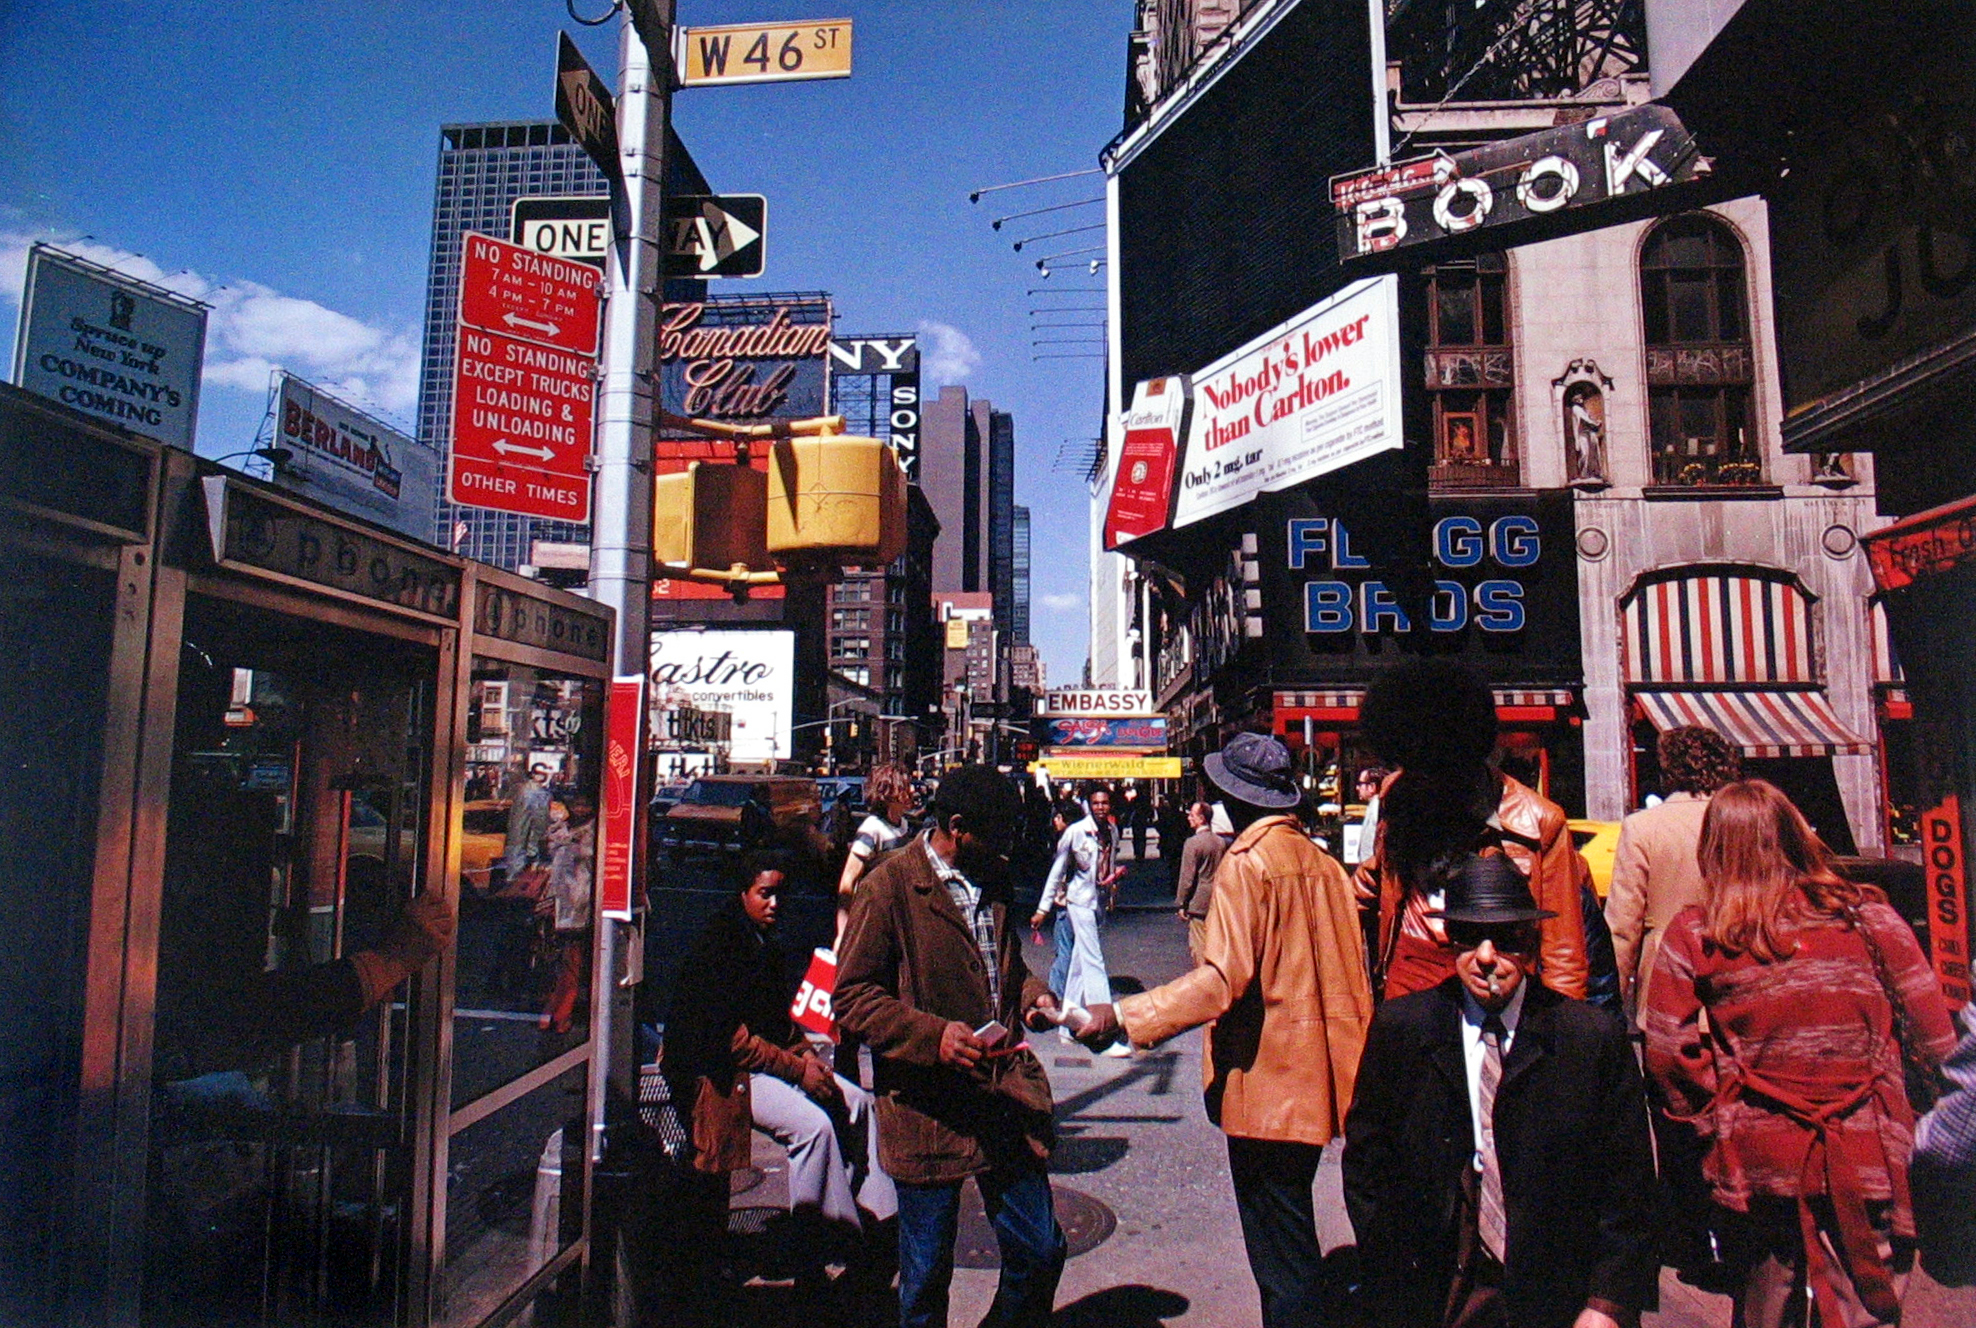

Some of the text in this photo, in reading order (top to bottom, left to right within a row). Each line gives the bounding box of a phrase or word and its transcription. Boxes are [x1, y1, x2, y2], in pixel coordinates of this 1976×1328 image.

[699, 28, 840, 77] W 46 ST
[1355, 128, 1673, 255] BOOK
[535, 223, 606, 252] ONE
[475, 242, 594, 290] NO STANDING
[492, 268, 501, 282] 7
[502, 272, 523, 287] AM
[540, 280, 554, 296] 10
[557, 286, 578, 302] AM
[488, 285, 498, 299] 4
[502, 290, 523, 305] PM
[542, 298, 550, 312] 7
[555, 302, 575, 318] PM
[71, 316, 138, 350] Spruce
[661, 302, 829, 360] Canadian
[74, 335, 160, 376] New York
[467, 334, 491, 356] NO
[505, 344, 588, 379] STANDING
[1203, 341, 1299, 420] Nobody's
[1302, 313, 1370, 370] lower
[40, 354, 181, 408] COMPANY'S
[462, 358, 590, 402] EXCEPT TRUCKS
[684, 358, 796, 416] Club
[59, 385, 162, 426] COMING
[475, 385, 574, 422] LOADING &
[1129, 411, 1164, 428] Carlton
[1204, 415, 1251, 452] than
[1253, 369, 1351, 429] Carlton.
[472, 408, 576, 446] UNLOADING
[891, 386, 918, 474] SONY
[461, 471, 578, 506] OTHER TIMES
[1185, 466, 1212, 490] Only
[1214, 460, 1221, 479] 2
[1244, 448, 1264, 467] tar
[1286, 515, 1541, 570] FLGG
[1304, 578, 1526, 634] BROS
[692, 688, 774, 703] convertibles
[1049, 694, 1148, 711] EMBASSY
[1931, 818, 1959, 925] DOGS
